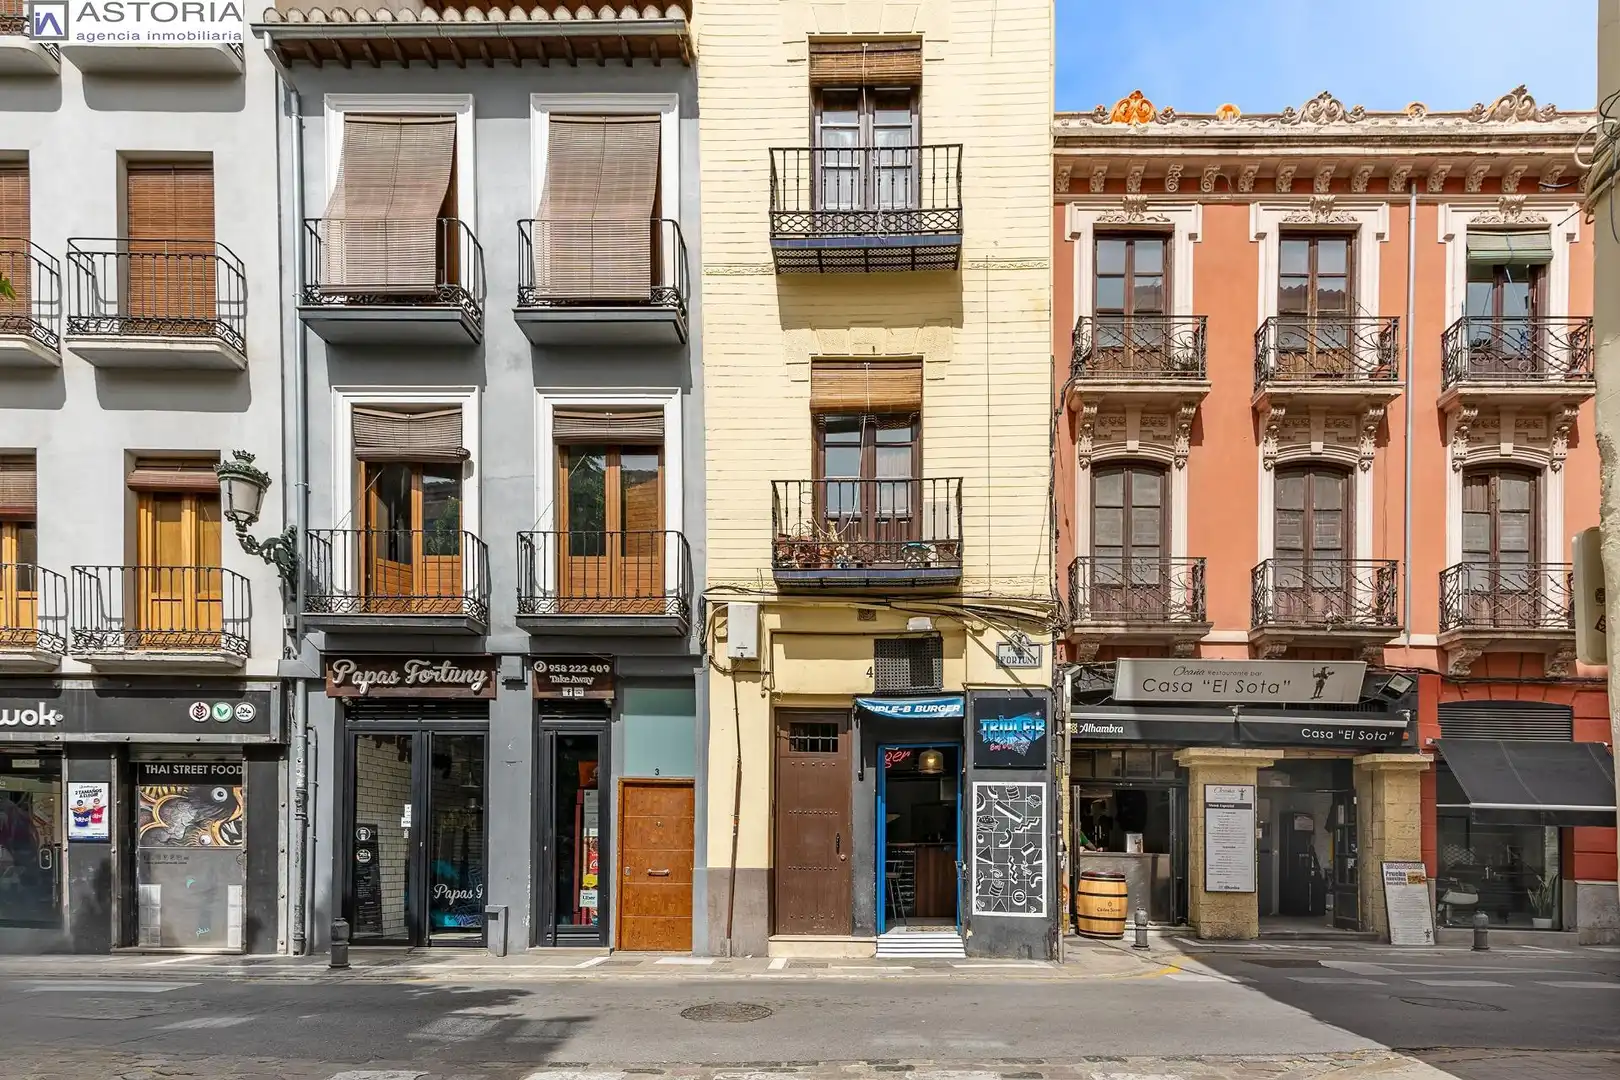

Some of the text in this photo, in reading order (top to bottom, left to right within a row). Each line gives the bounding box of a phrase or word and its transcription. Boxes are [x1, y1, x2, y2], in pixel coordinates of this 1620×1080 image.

[549, 664, 611, 673] 958 222 409
[866, 666, 873, 678] 4
[332, 659, 488, 694] Papas Fortuny
[550, 675, 595, 685] Take Away
[1142, 678, 1193, 693] Casa
[914, 704, 961, 713] BURGER
[1080, 723, 1124, 734] Alhambra
[1301, 728, 1334, 739] Casa
[145, 764, 244, 775] THAI STREET FOOD
[654, 768, 660, 776] 3
[433, 883, 473, 906] Papas
